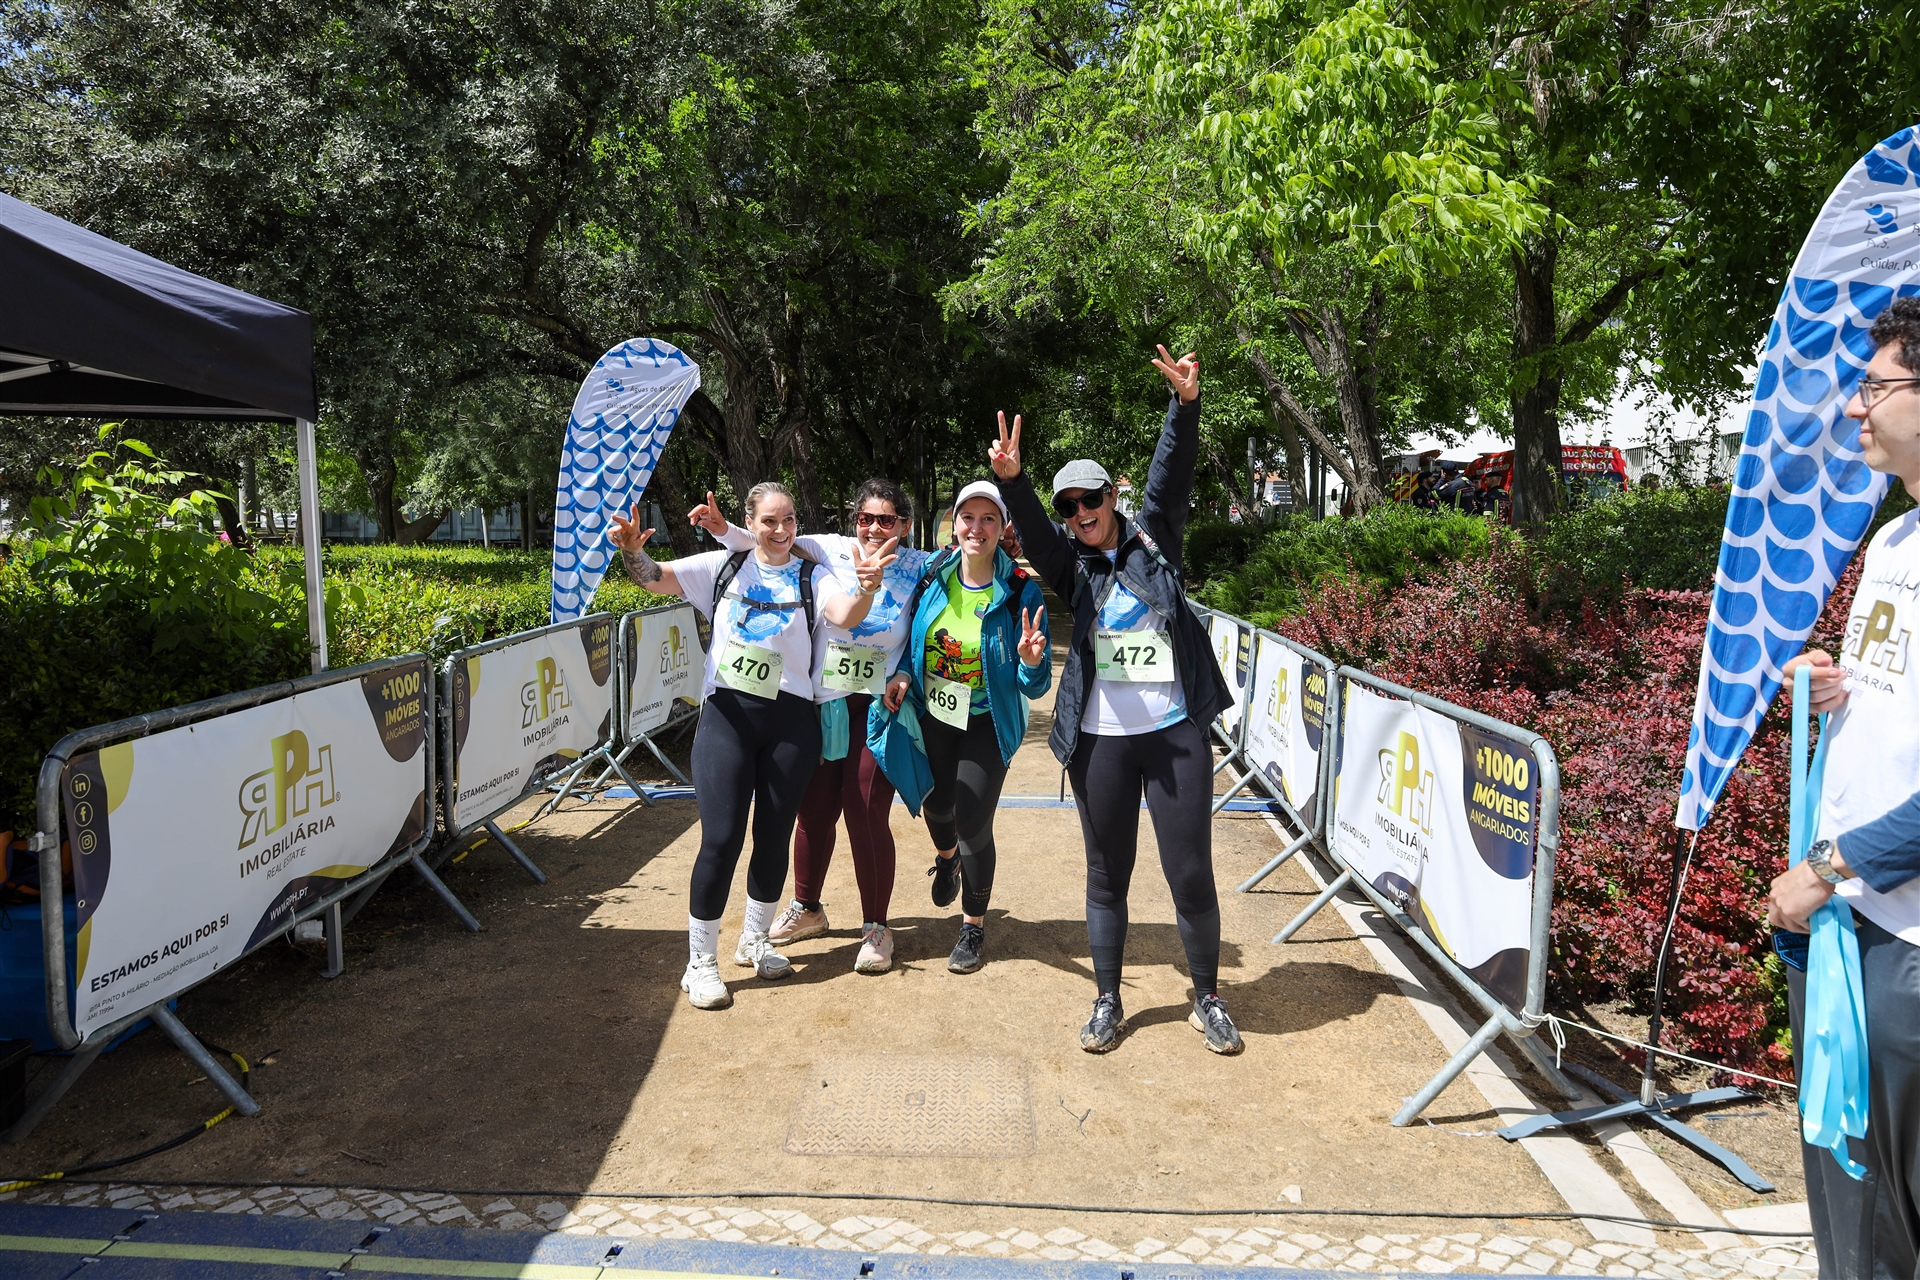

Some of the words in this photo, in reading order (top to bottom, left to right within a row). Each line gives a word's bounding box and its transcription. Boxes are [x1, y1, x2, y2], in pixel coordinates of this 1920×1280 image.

[731, 655, 770, 681] 470
[838, 657, 875, 679] 515
[1112, 645, 1157, 666] 472
[381, 671, 420, 701] +1000
[929, 687, 958, 712] 469
[384, 698, 420, 727] IMÓVEIS
[385, 718, 420, 742] ANGARIADOS
[1476, 746, 1529, 791] +1000
[1472, 782, 1530, 824] IMÓVEIS
[1470, 808, 1529, 846] ANGARIADOS
[240, 815, 336, 879] IMOBILIÁRIA
[1395, 848, 1418, 867] ESTATE
[266, 863, 283, 880] REAL
[283, 846, 307, 869] ESTATE
[91, 950, 159, 993] ESTAMOS
[161, 933, 193, 960] AQUI
[195, 920, 218, 942] POR
[220, 913, 230, 929] SI
[101, 993, 121, 1006] PINTO
